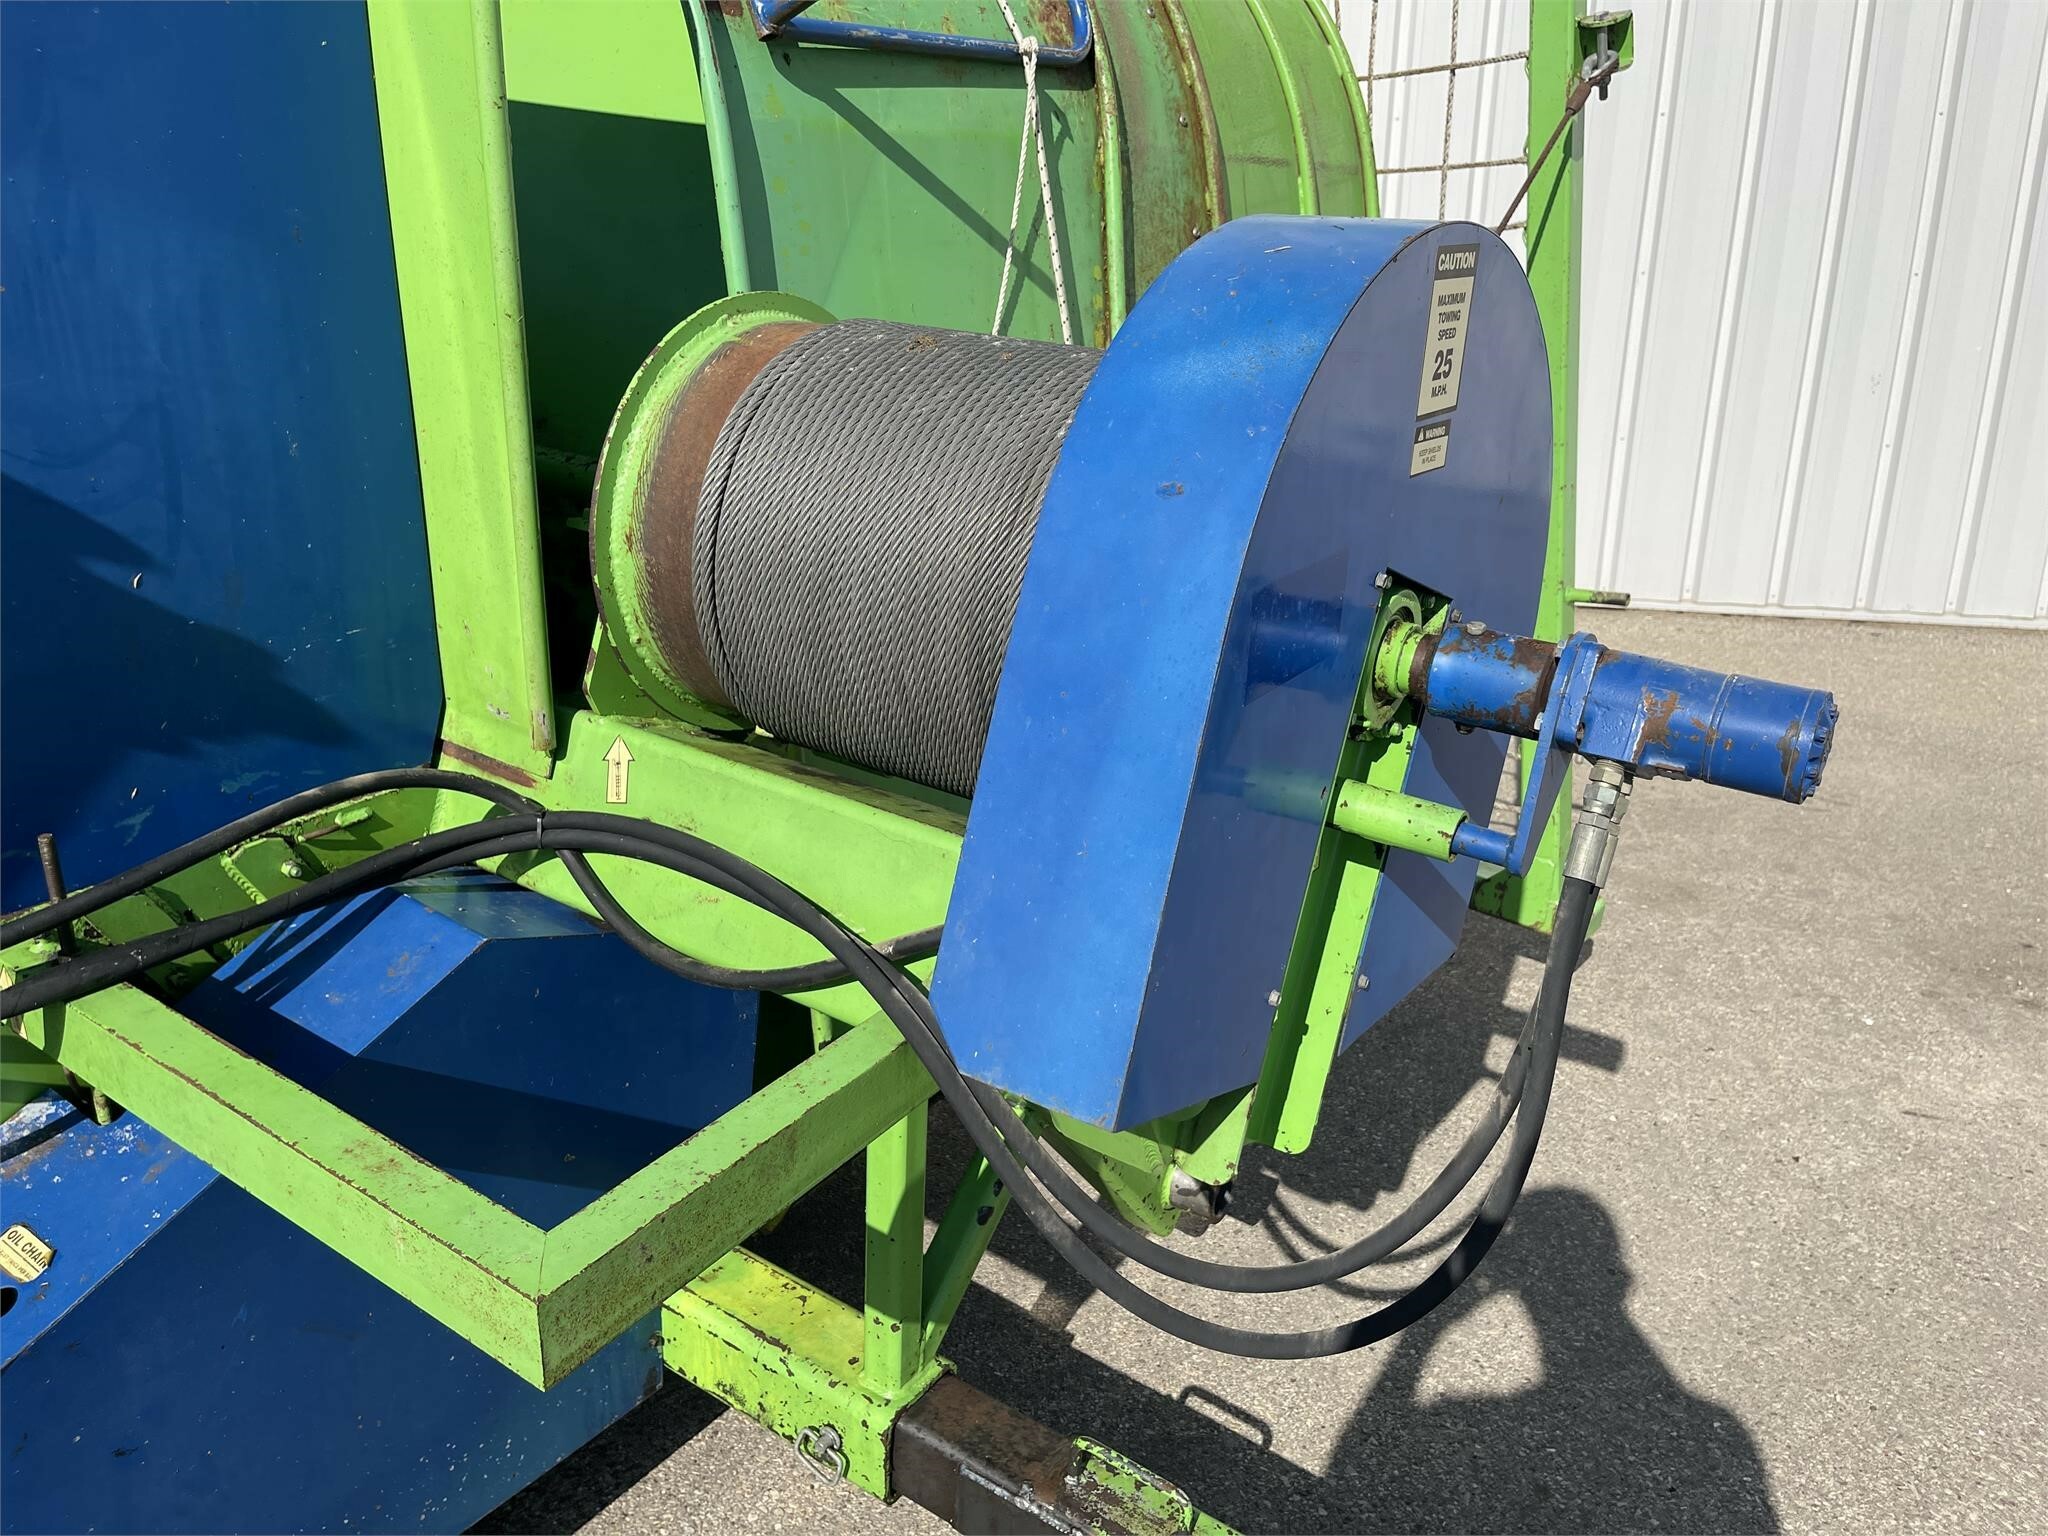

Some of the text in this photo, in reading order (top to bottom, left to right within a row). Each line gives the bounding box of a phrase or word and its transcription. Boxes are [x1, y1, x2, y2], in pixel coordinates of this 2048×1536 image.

[1437, 251, 1476, 271] CAUTION
[1437, 292, 1467, 307] MAXIMUM
[1438, 310, 1461, 324] TOWING
[1437, 328, 1457, 341] SPEED
[1431, 348, 1454, 382] 25
[8, 1230, 24, 1246] OIL
